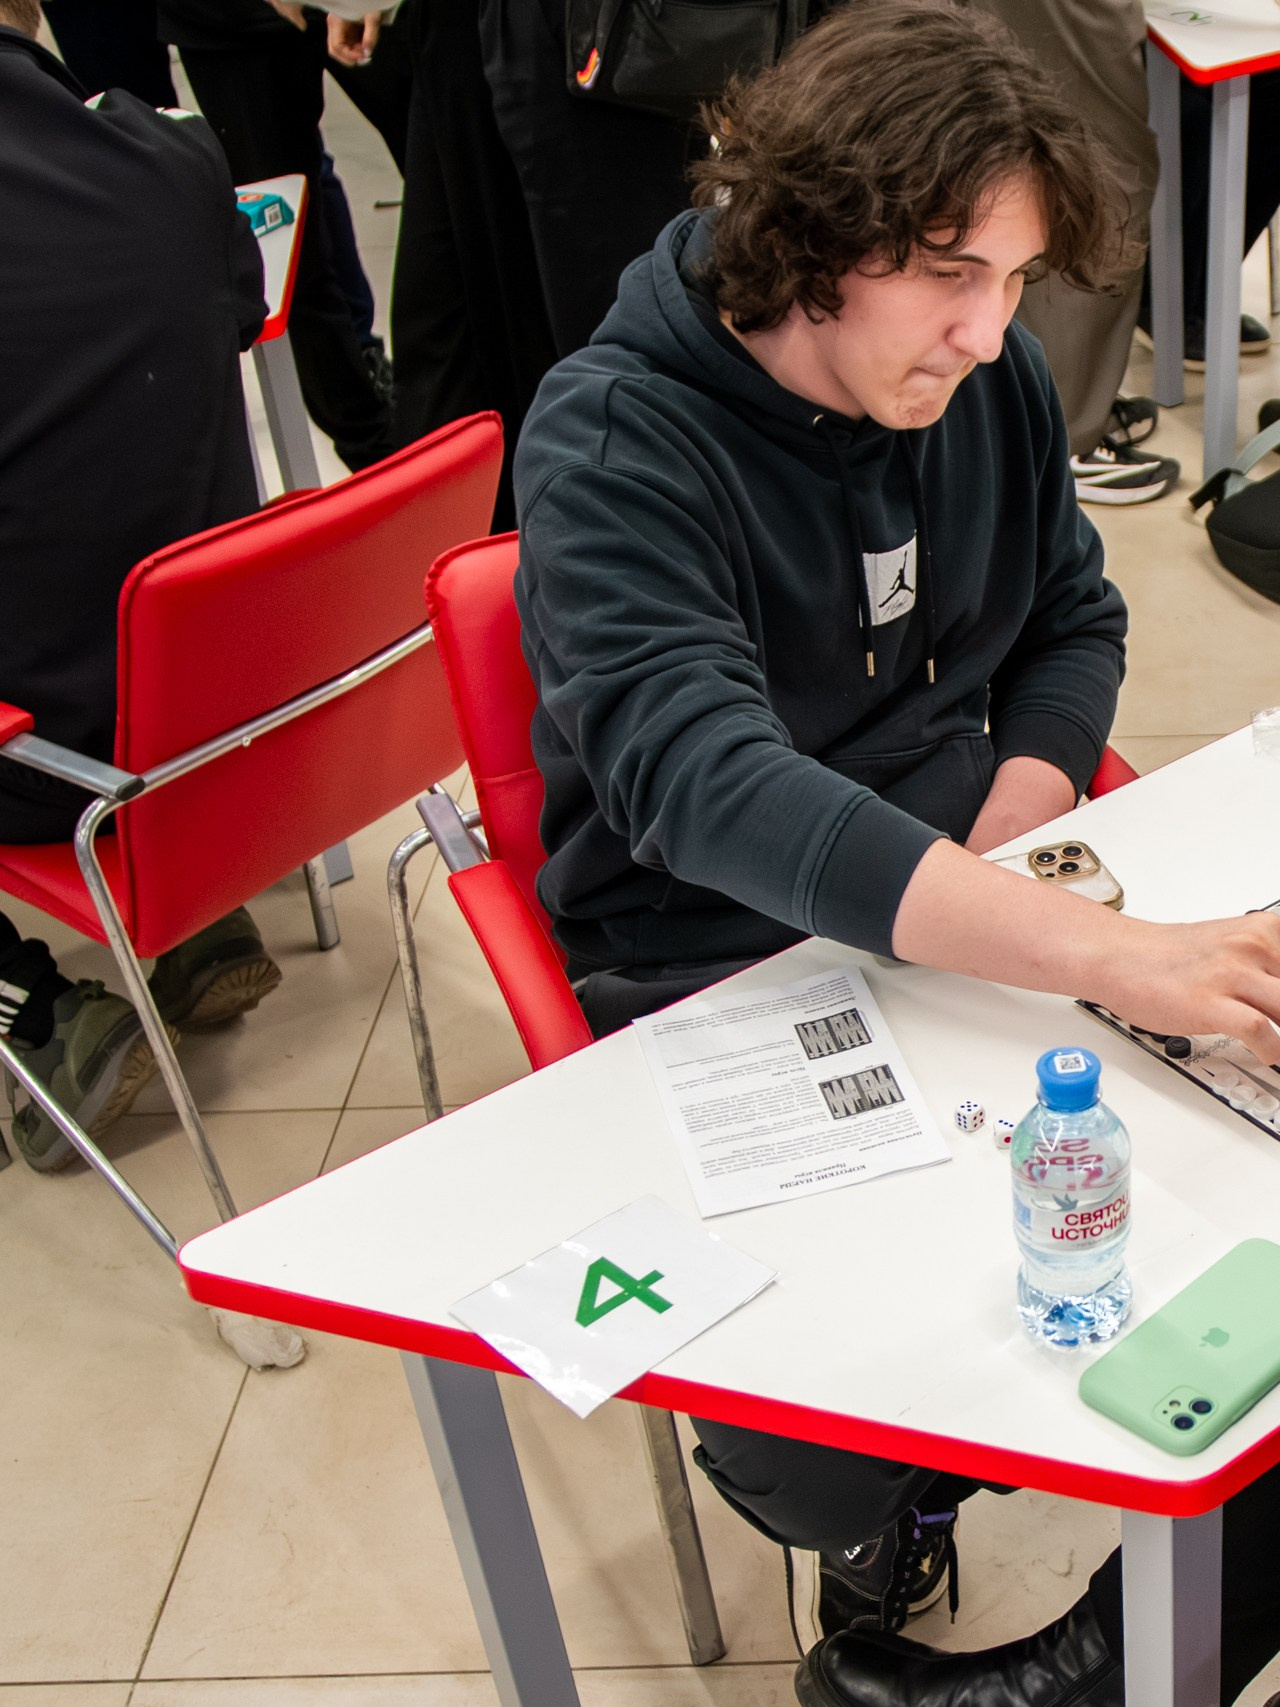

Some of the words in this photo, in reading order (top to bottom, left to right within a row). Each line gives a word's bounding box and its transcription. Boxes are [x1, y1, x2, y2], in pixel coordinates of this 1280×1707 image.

[815, 1164, 867, 1182] КОРОТКИЕ
[779, 1177, 813, 1190] НАРДЫ
[574, 1256, 674, 1329] 4
